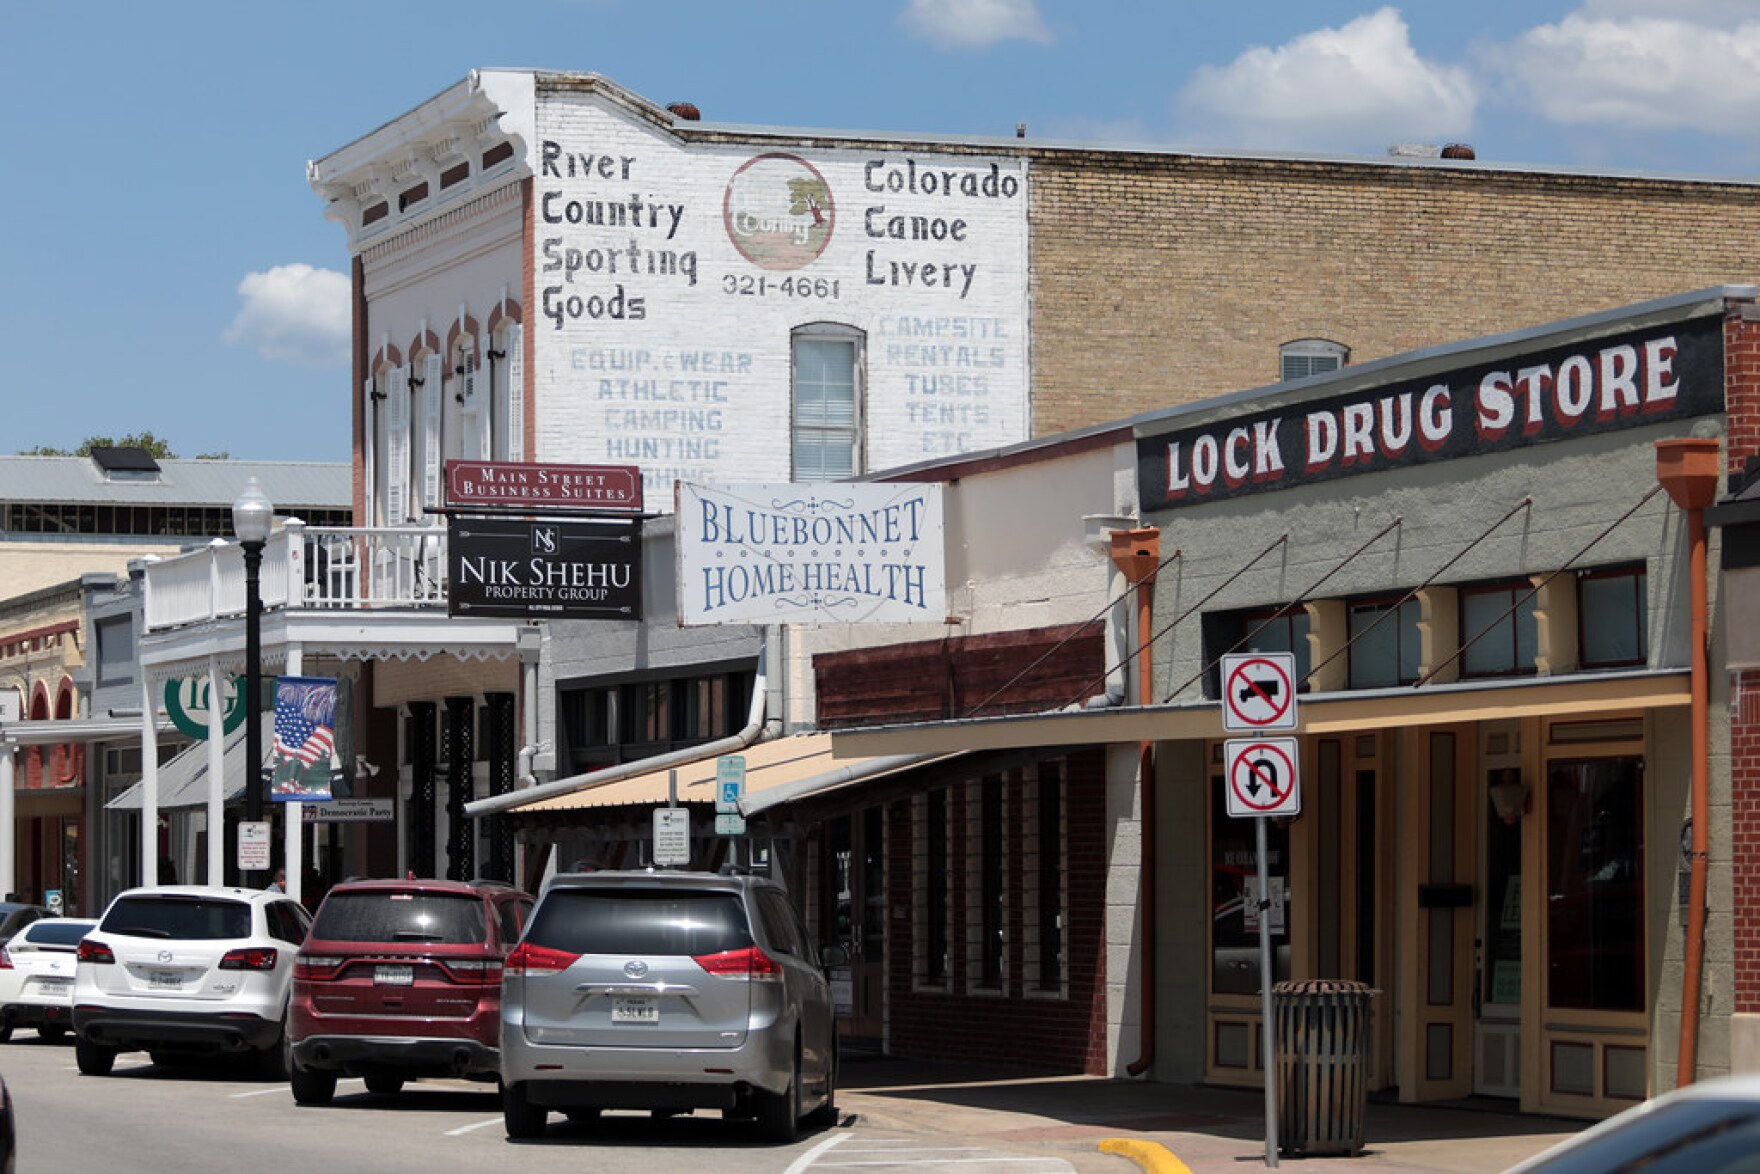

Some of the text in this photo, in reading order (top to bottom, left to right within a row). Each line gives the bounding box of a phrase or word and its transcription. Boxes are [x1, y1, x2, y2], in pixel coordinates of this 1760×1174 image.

[541, 140, 635, 179] River
[864, 160, 1019, 199] Colorado
[541, 190, 685, 239] Country
[864, 205, 967, 241] Canoe
[541, 237, 698, 286] Sporting
[865, 250, 977, 298] Livery
[722, 274, 841, 299] 321-4661
[541, 285, 647, 330] Goods
[878, 316, 1010, 340] CAMPSITE
[885, 343, 1005, 368] RENTALS
[596, 379, 729, 402] ATHLETIC
[905, 373, 990, 395] TUBES
[604, 408, 723, 431] CAMPING
[905, 402, 990, 425] TENTS
[1165, 336, 1680, 500] LOCK DRUG STORE
[605, 438, 720, 460] HUNTING
[481, 468, 606, 485] MAIN STREET
[462, 479, 626, 500] BUSINESS SUITES
[700, 498, 924, 545] BLUEBONNET
[460, 556, 632, 588] NIK SHEHU
[485, 586, 608, 601] PROPERTY GROUP
[702, 563, 928, 611] HOME HEALTH
[320, 807, 391, 820] Democratic Party
